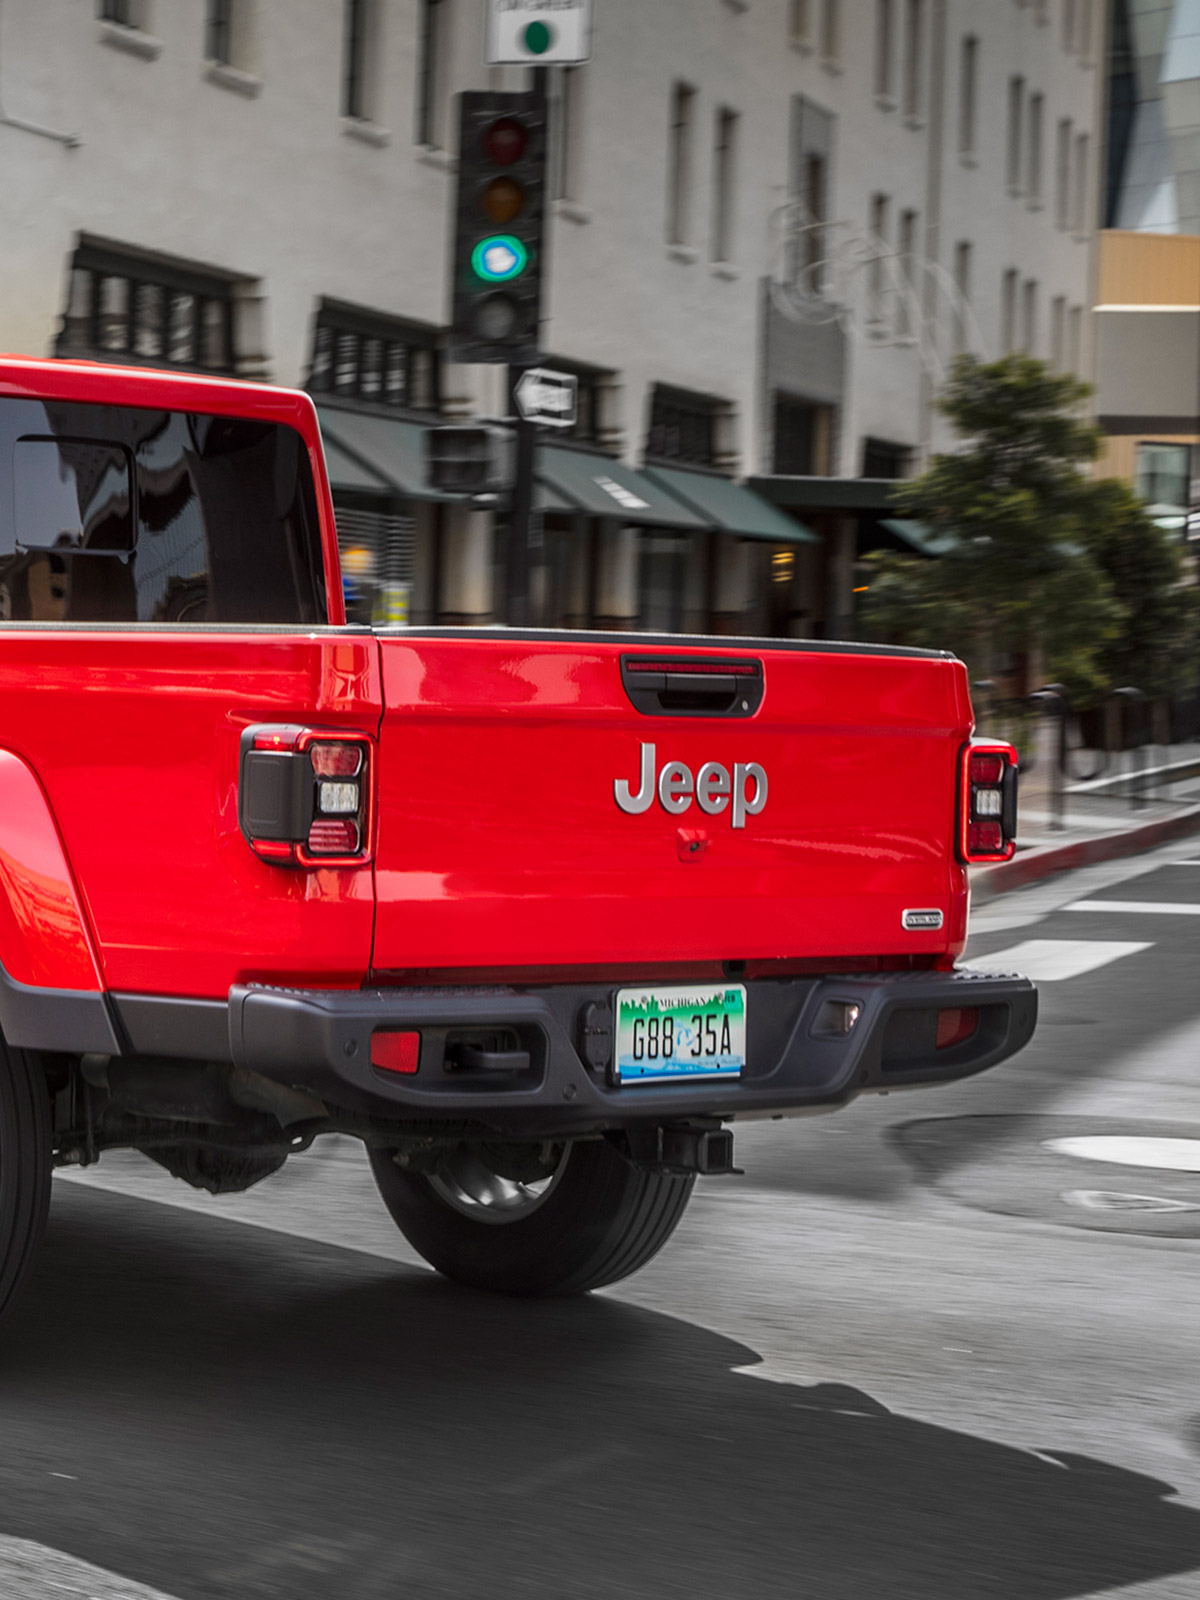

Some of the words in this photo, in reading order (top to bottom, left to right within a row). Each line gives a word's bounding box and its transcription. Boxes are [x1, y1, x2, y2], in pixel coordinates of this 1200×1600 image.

[613, 742, 768, 829] Jeep
[660, 996, 707, 1008] MICHIGAN
[633, 1016, 673, 1060] G88
[691, 1014, 731, 1056] 35A
